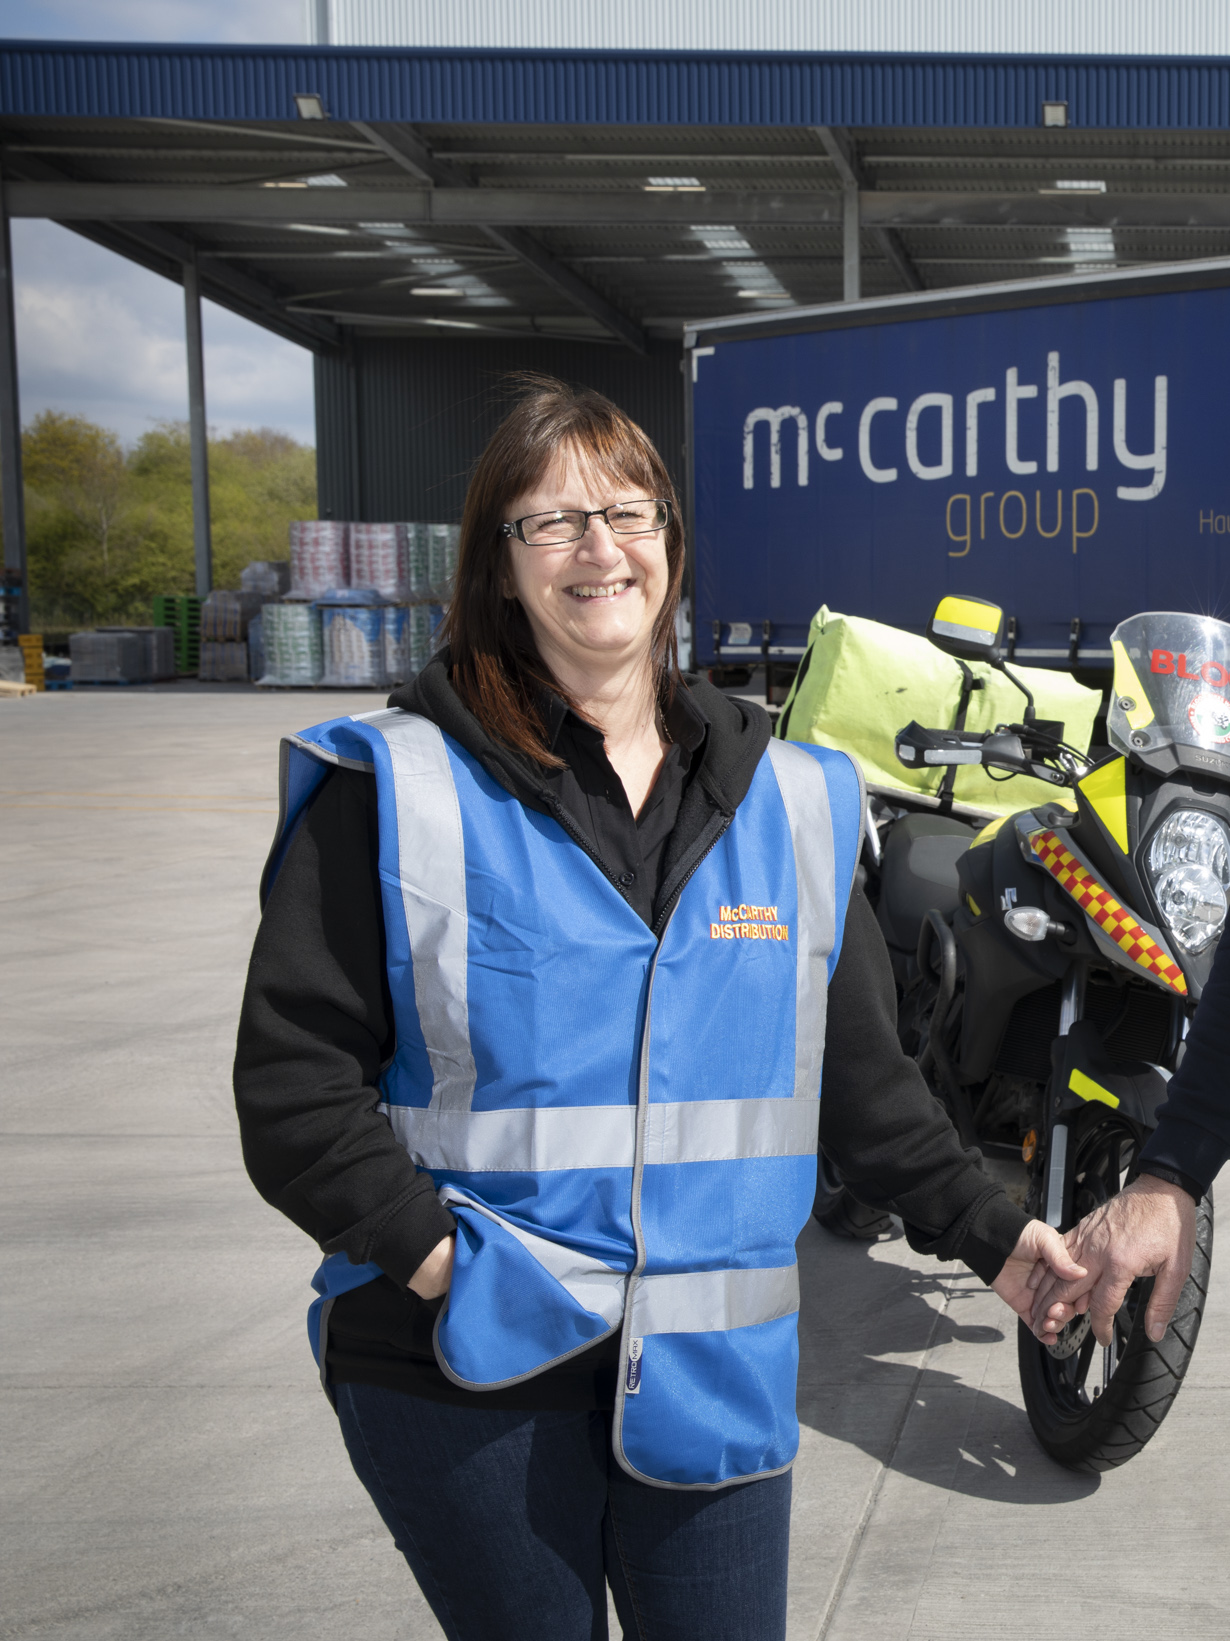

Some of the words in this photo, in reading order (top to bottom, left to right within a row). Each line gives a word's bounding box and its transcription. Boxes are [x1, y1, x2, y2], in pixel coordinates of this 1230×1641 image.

[946, 488, 1099, 557] group
[719, 904, 778, 922] McCARTHY
[710, 923, 789, 941] DISTRIBUTION
